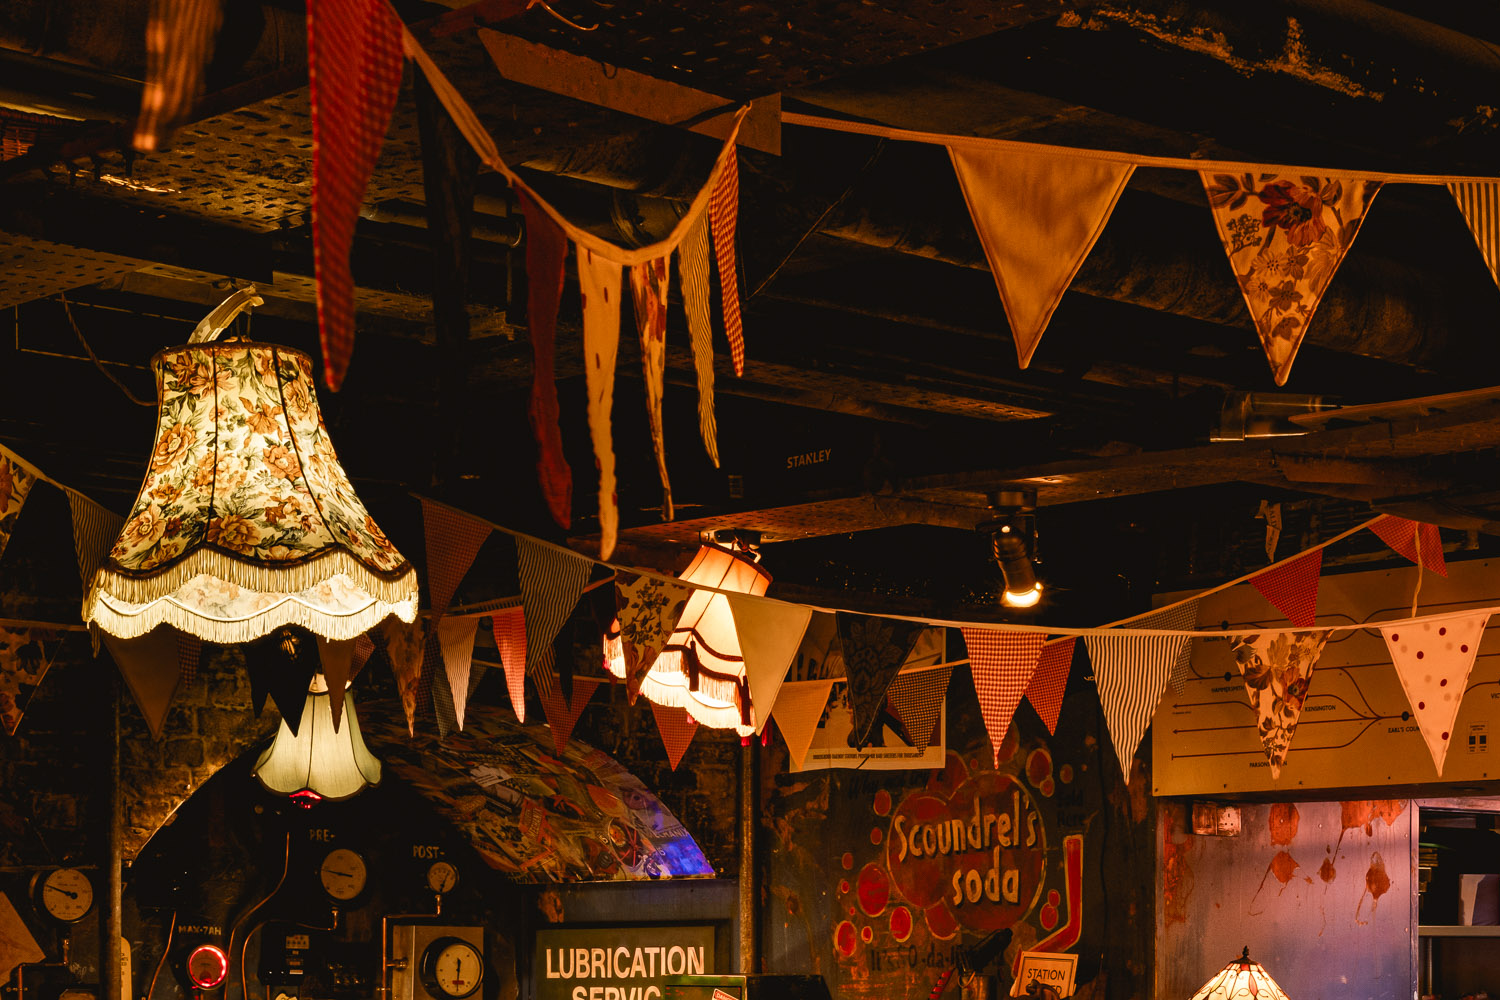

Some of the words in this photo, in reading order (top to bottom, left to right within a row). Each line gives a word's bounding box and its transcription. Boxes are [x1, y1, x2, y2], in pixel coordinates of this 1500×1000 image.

[786, 448, 832, 469] STANLEY
[1304, 704, 1336, 712] KENSINGTON
[1388, 726, 1404, 734] EARL'S
[894, 790, 1038, 863] Scoundrel's
[309, 828, 336, 842] PRE-
[412, 845, 446, 859] POST-
[952, 845, 1020, 907] soda
[546, 946, 705, 979] LUBRICATION
[1027, 968, 1066, 981] STATION
